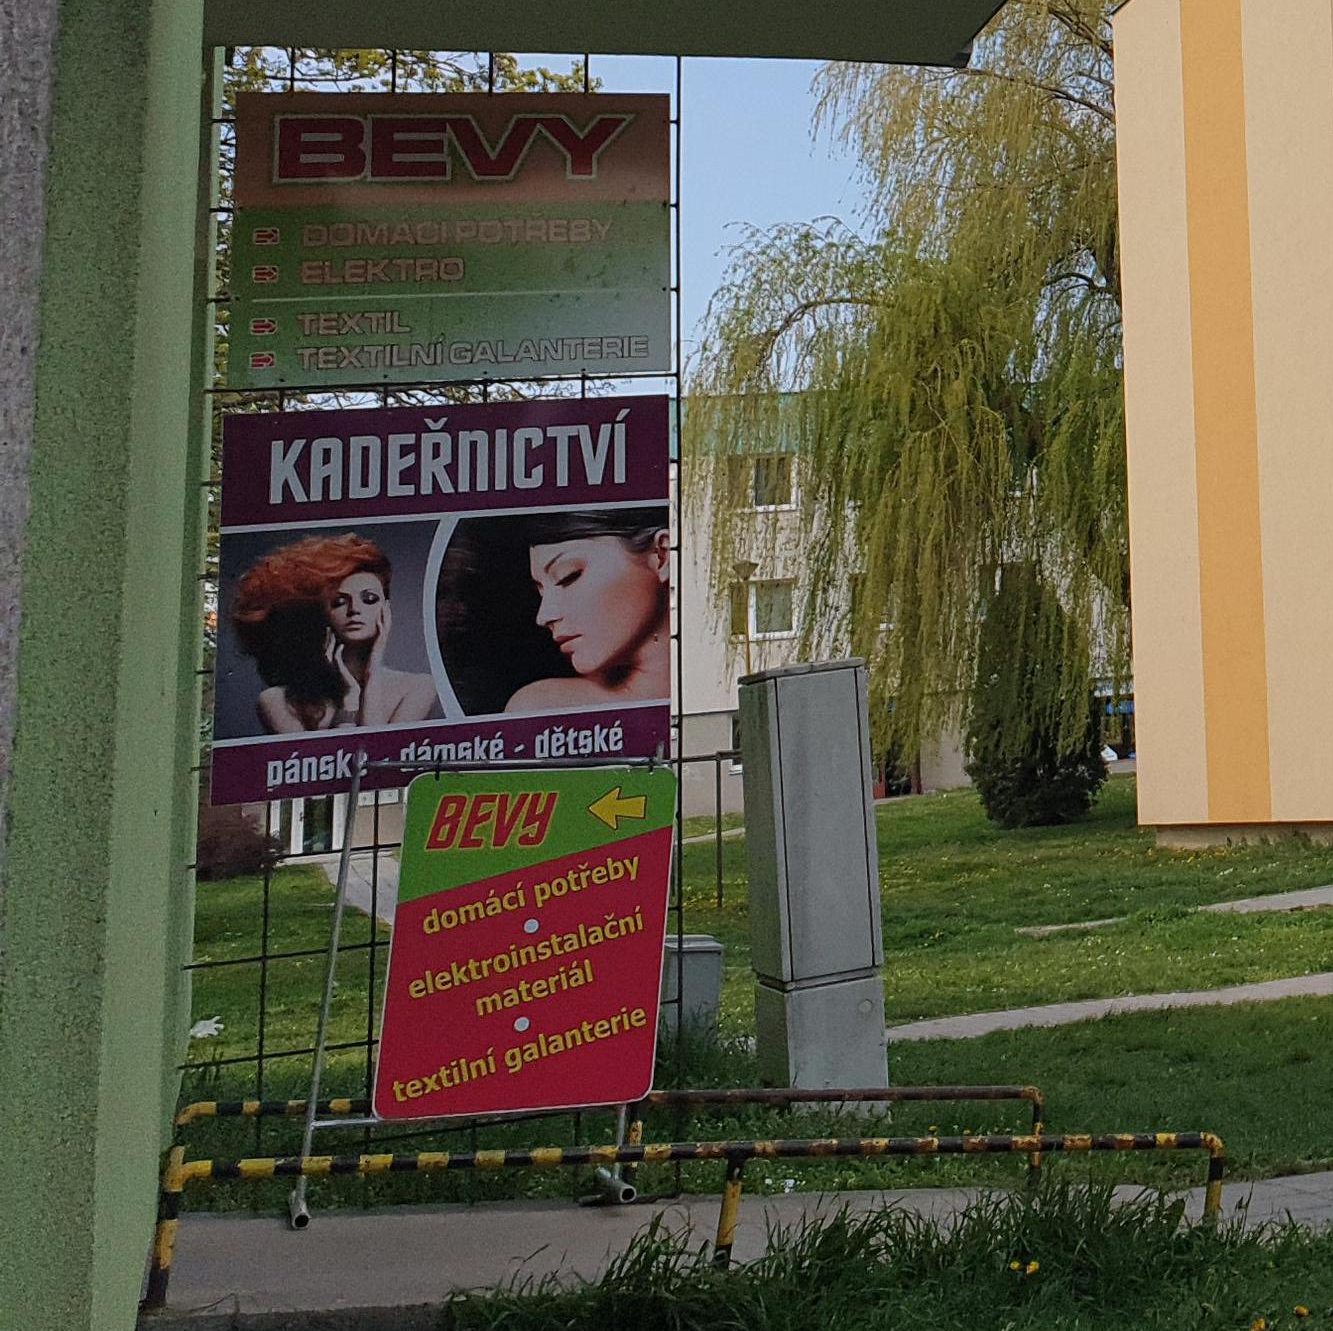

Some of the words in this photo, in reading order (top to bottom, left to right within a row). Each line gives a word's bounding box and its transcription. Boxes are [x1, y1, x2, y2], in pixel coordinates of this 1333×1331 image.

[273, 114, 635, 183] BEVY
[300, 258, 465, 284] ELEKTRO
[297, 311, 412, 337] TEXTIL
[297, 337, 446, 371] TEXTILNÍ
[449, 336, 650, 366] GALANTERIE
[268, 408, 632, 506] KADEŘNICTVÍ
[534, 719, 626, 760] dětské
[424, 790, 560, 852] BEVY
[421, 881, 527, 936] domácí
[534, 853, 641, 909] potřeby
[407, 905, 645, 1001] elektroinstalační
[474, 958, 594, 1017] materiál
[391, 1046, 497, 1104] textilní
[503, 1006, 648, 1074] galanterie
